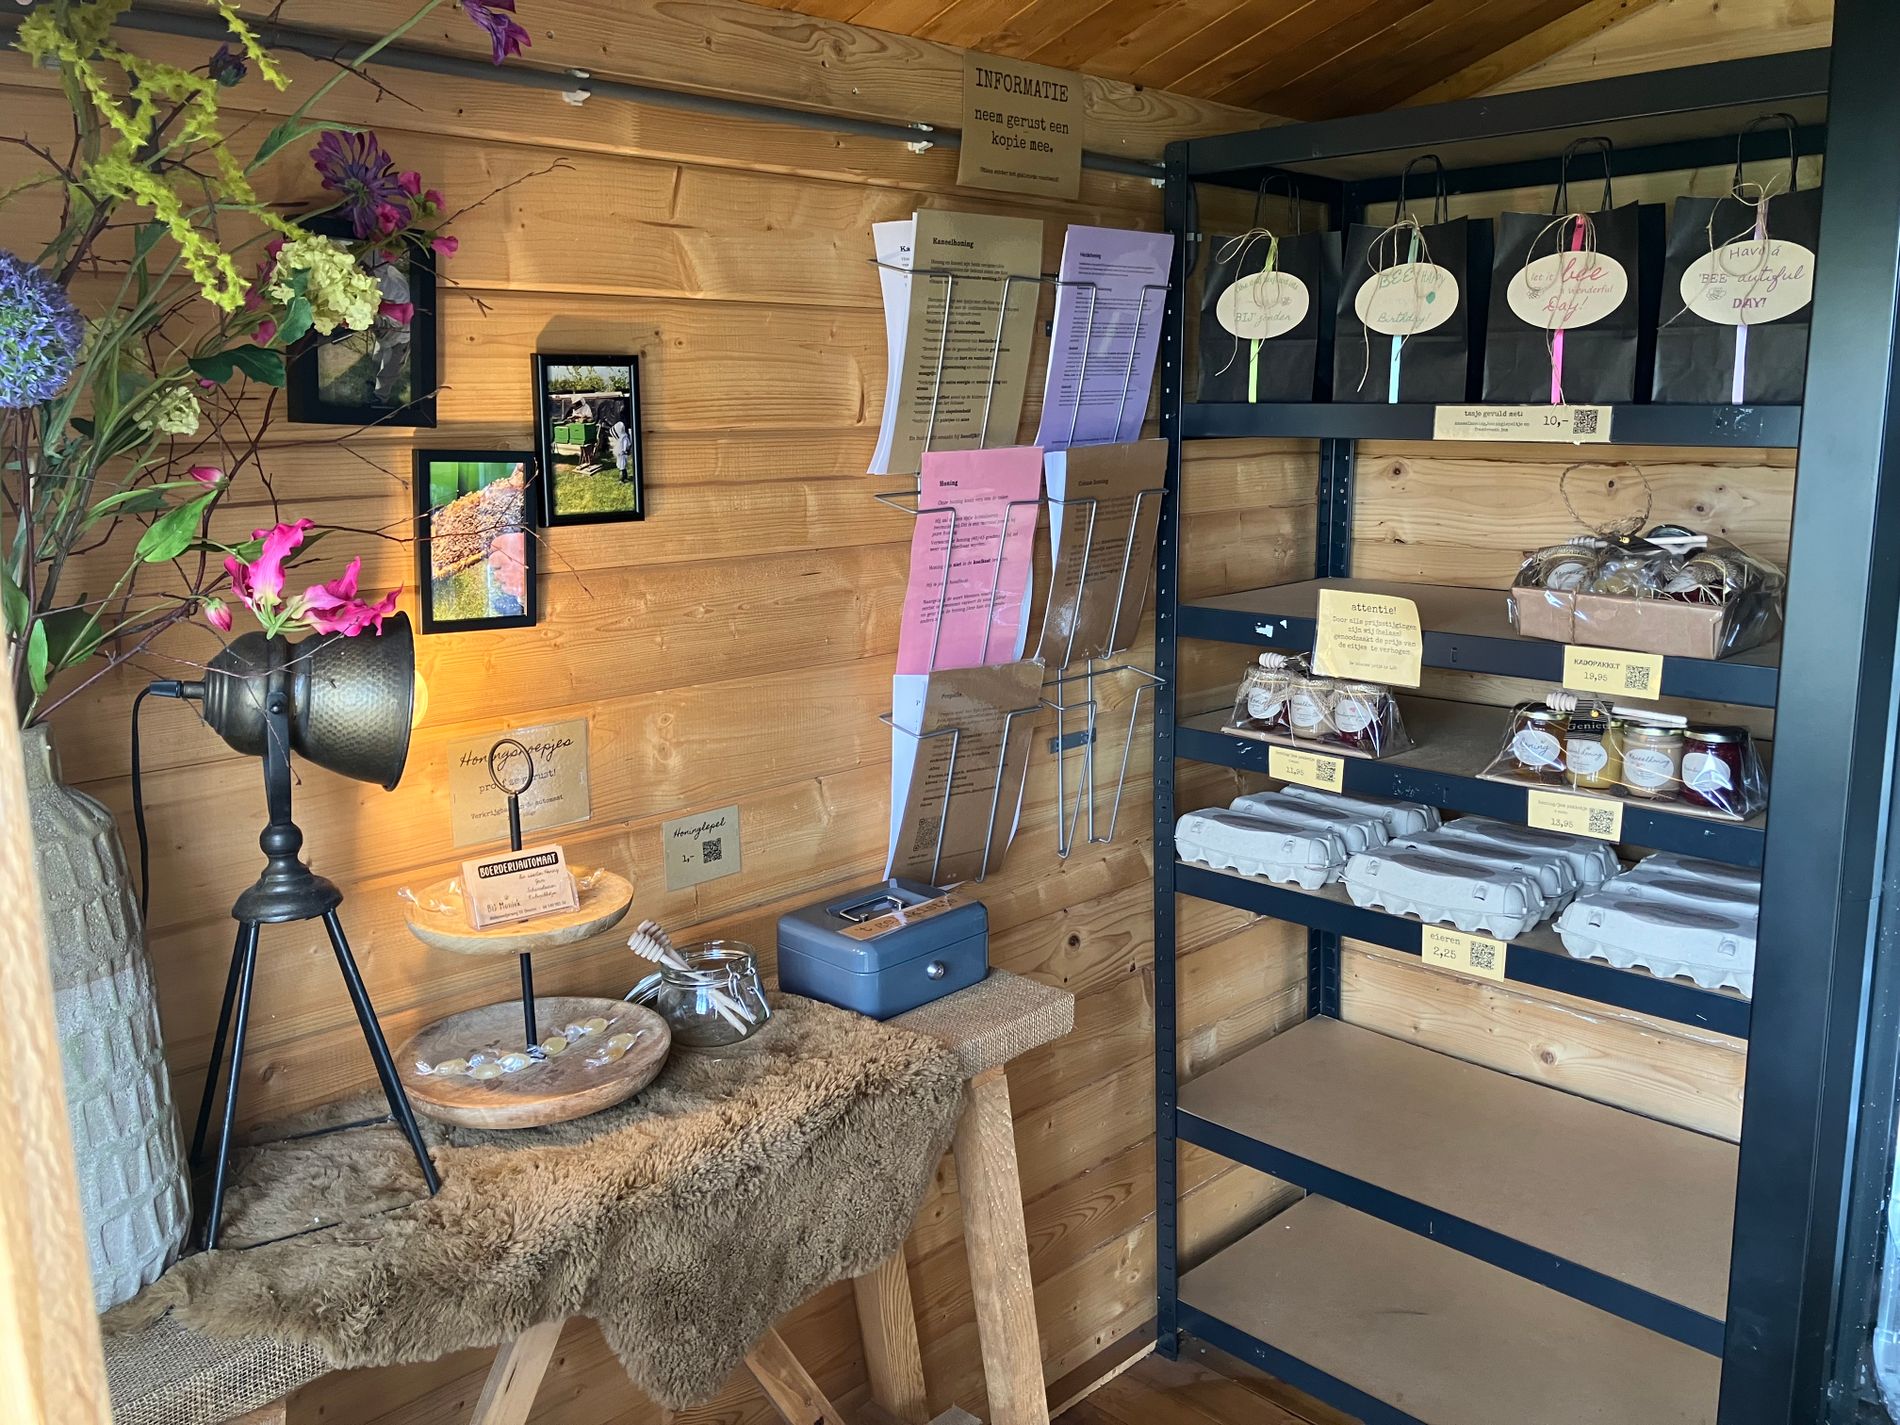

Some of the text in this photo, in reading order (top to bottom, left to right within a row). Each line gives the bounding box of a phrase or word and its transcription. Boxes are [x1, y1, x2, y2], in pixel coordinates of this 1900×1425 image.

[975, 67, 1069, 102] INFORMATIE
[974, 108, 1069, 134] neem gerust een
[991, 130, 1054, 152] kopie mee.
[1561, 257, 1609, 283] bee
[1351, 603, 1398, 615] attentie!
[1583, 671, 1608, 682] 19,95
[459, 737, 574, 772] Honngsoepjes
[479, 778, 507, 795] prof
[673, 816, 727, 840] Honinglepel
[1430, 933, 1461, 945] eieren
[1432, 945, 1457, 960] 2,25
